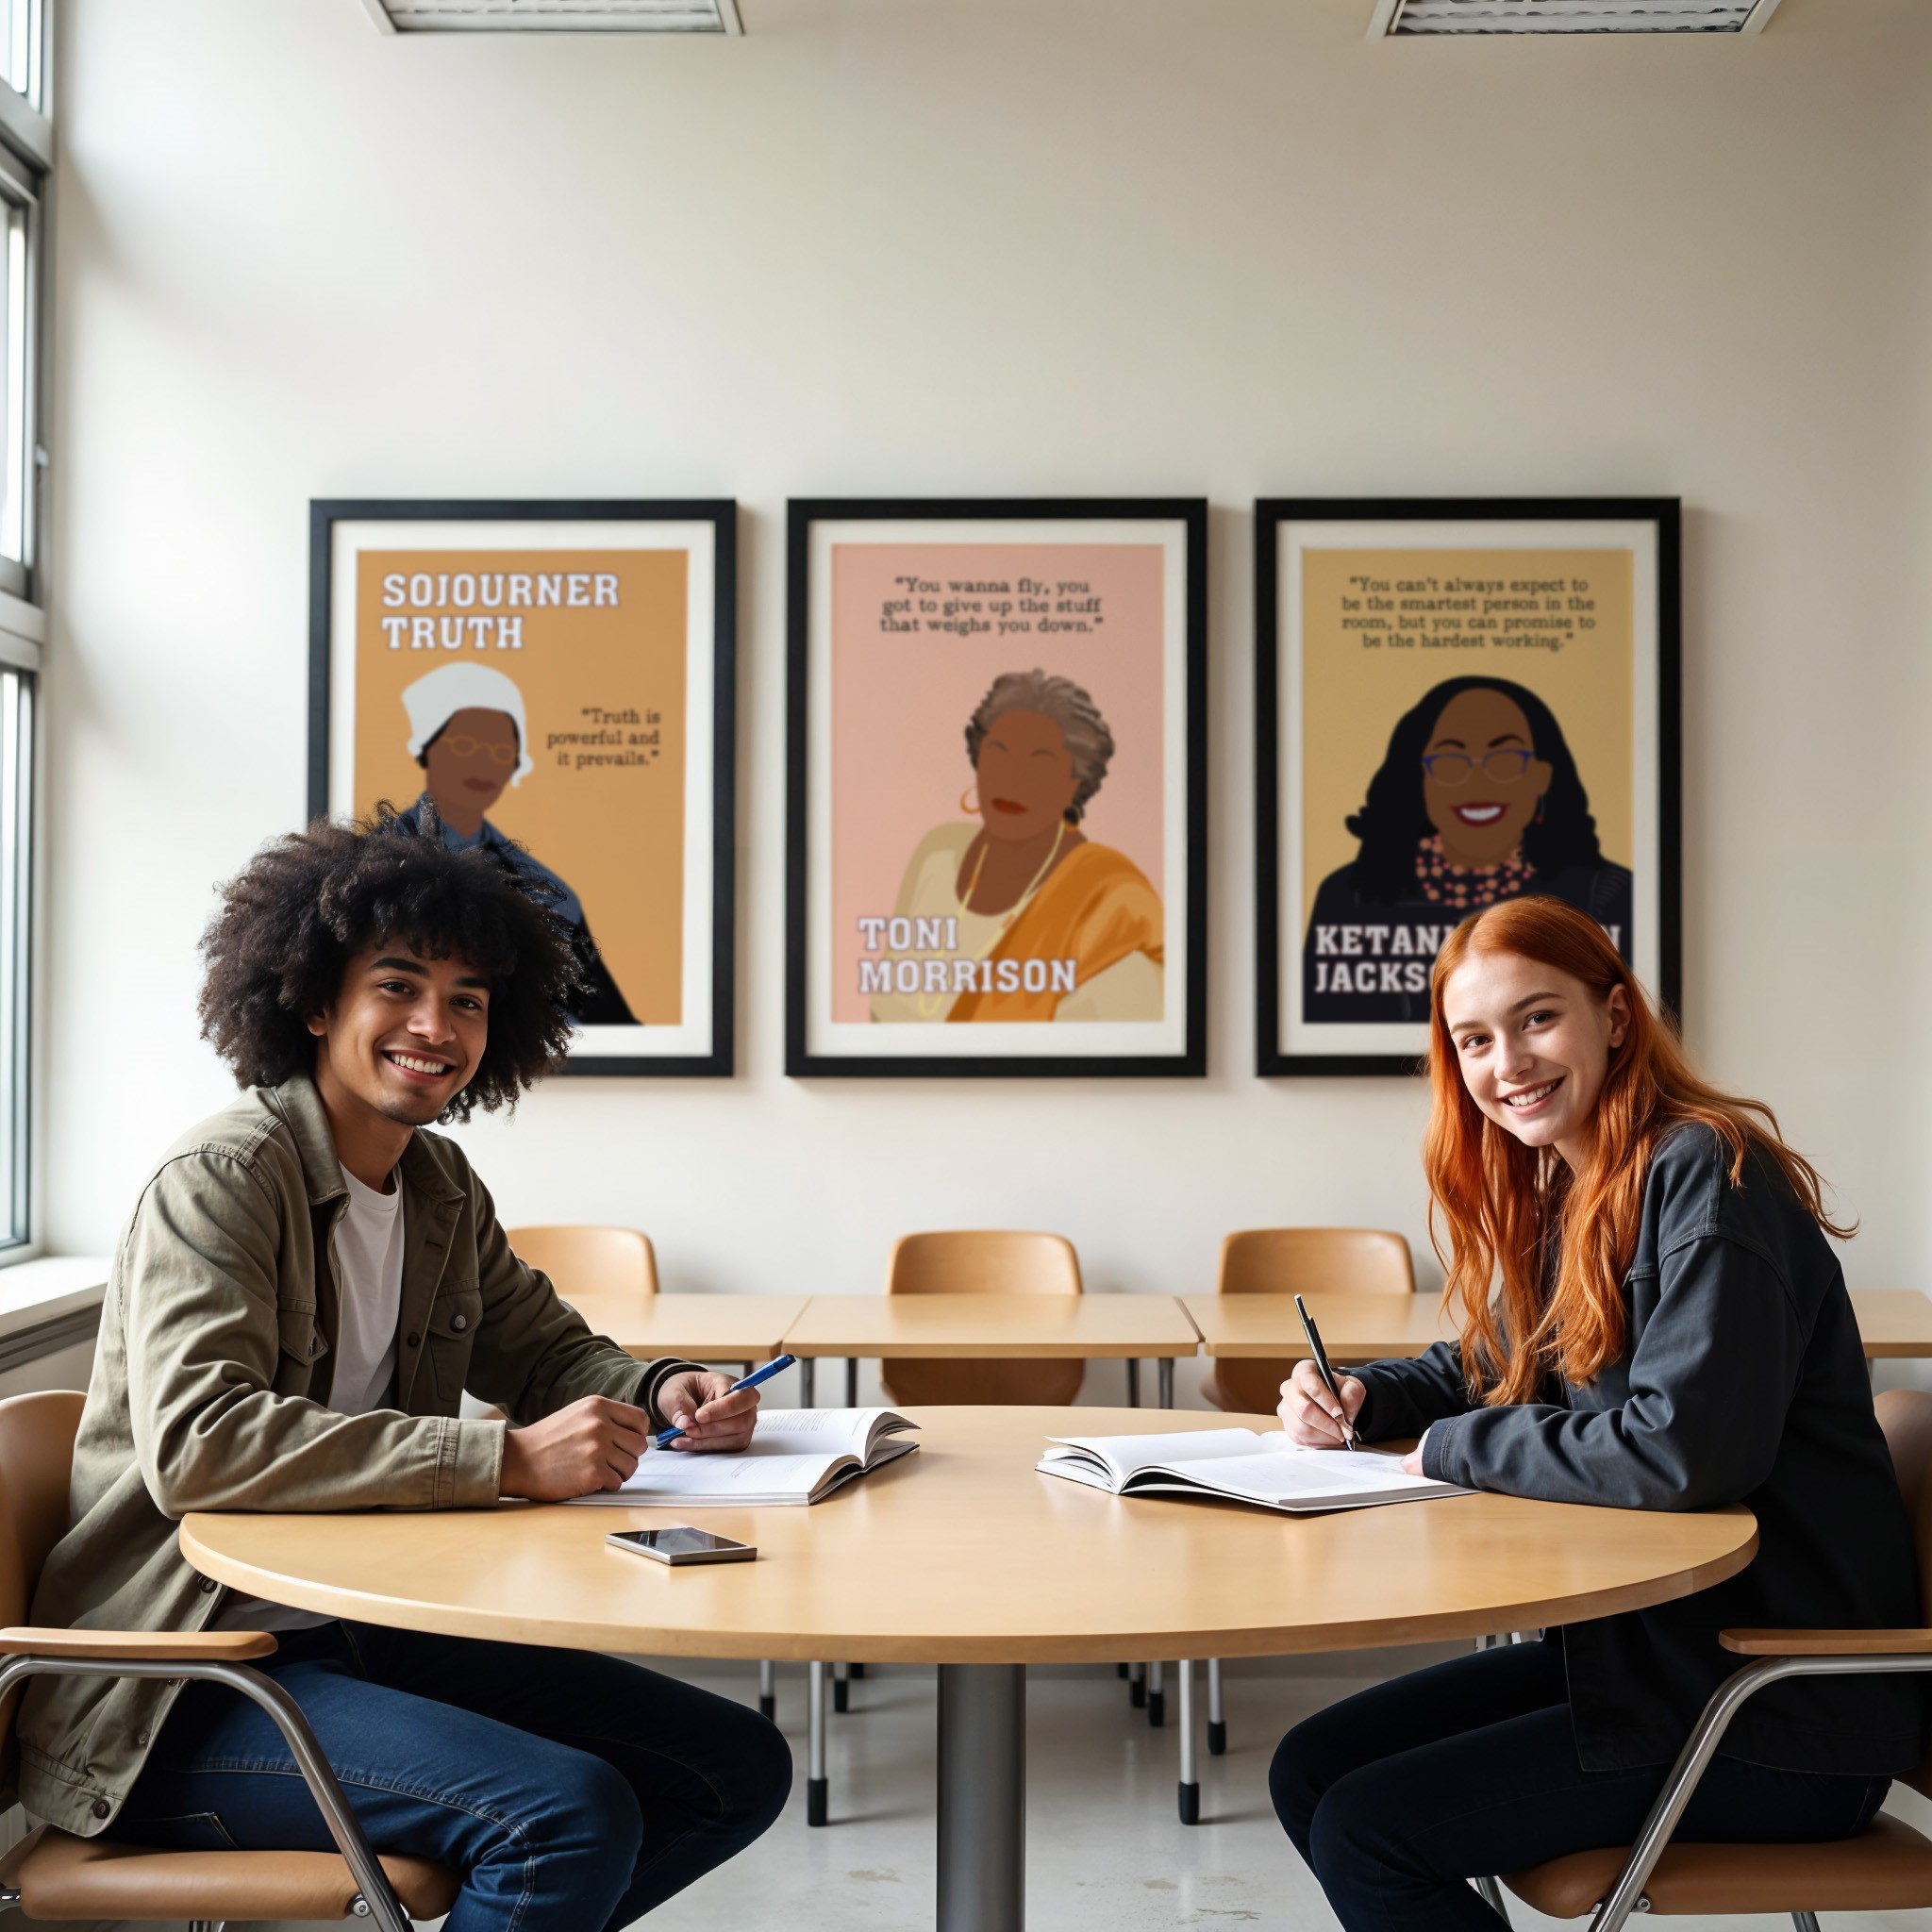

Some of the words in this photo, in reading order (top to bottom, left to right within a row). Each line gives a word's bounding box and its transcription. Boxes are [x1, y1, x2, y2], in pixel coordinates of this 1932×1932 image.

[382, 573, 620, 608] SOJOURNER
[948, 580, 1011, 593] wanna
[1017, 577, 1050, 596] fly,
[1057, 580, 1091, 596] you
[1444, 577, 1505, 594] always
[1509, 579, 1565, 595] expect
[1572, 579, 1590, 591] to
[882, 598, 911, 617] got
[919, 599, 938, 612] to
[943, 597, 982, 617] give
[989, 600, 1013, 617] up
[1019, 598, 1050, 613] the
[1056, 598, 1102, 613] stuff
[1341, 597, 1360, 610] be
[1367, 597, 1394, 610] the
[1400, 597, 1477, 610] smartest
[1483, 599, 1539, 614] person
[1545, 596, 1561, 610] in
[1568, 596, 1595, 610] the
[380, 615, 524, 650] TRUTH
[880, 618, 920, 632] that
[927, 618, 991, 637] weighs
[998, 621, 1031, 636] you
[1341, 618, 1392, 630] room,
[1398, 616, 1425, 629] but
[1432, 618, 1461, 631] you
[1468, 618, 1497, 629] can
[1504, 616, 1573, 632] promise
[1578, 616, 1596, 629] to
[1362, 634, 1381, 648] be
[1387, 634, 1415, 648] the
[1421, 634, 1486, 648] hardest
[645, 708, 661, 724] is
[546, 729, 623, 750] powerful
[628, 729, 659, 745] and
[558, 751, 570, 766] it
[858, 917, 958, 951] TONI
[1315, 924, 1454, 955] KETAN
[858, 959, 1077, 993] MORRISON
[1314, 962, 1435, 992] JACKS
